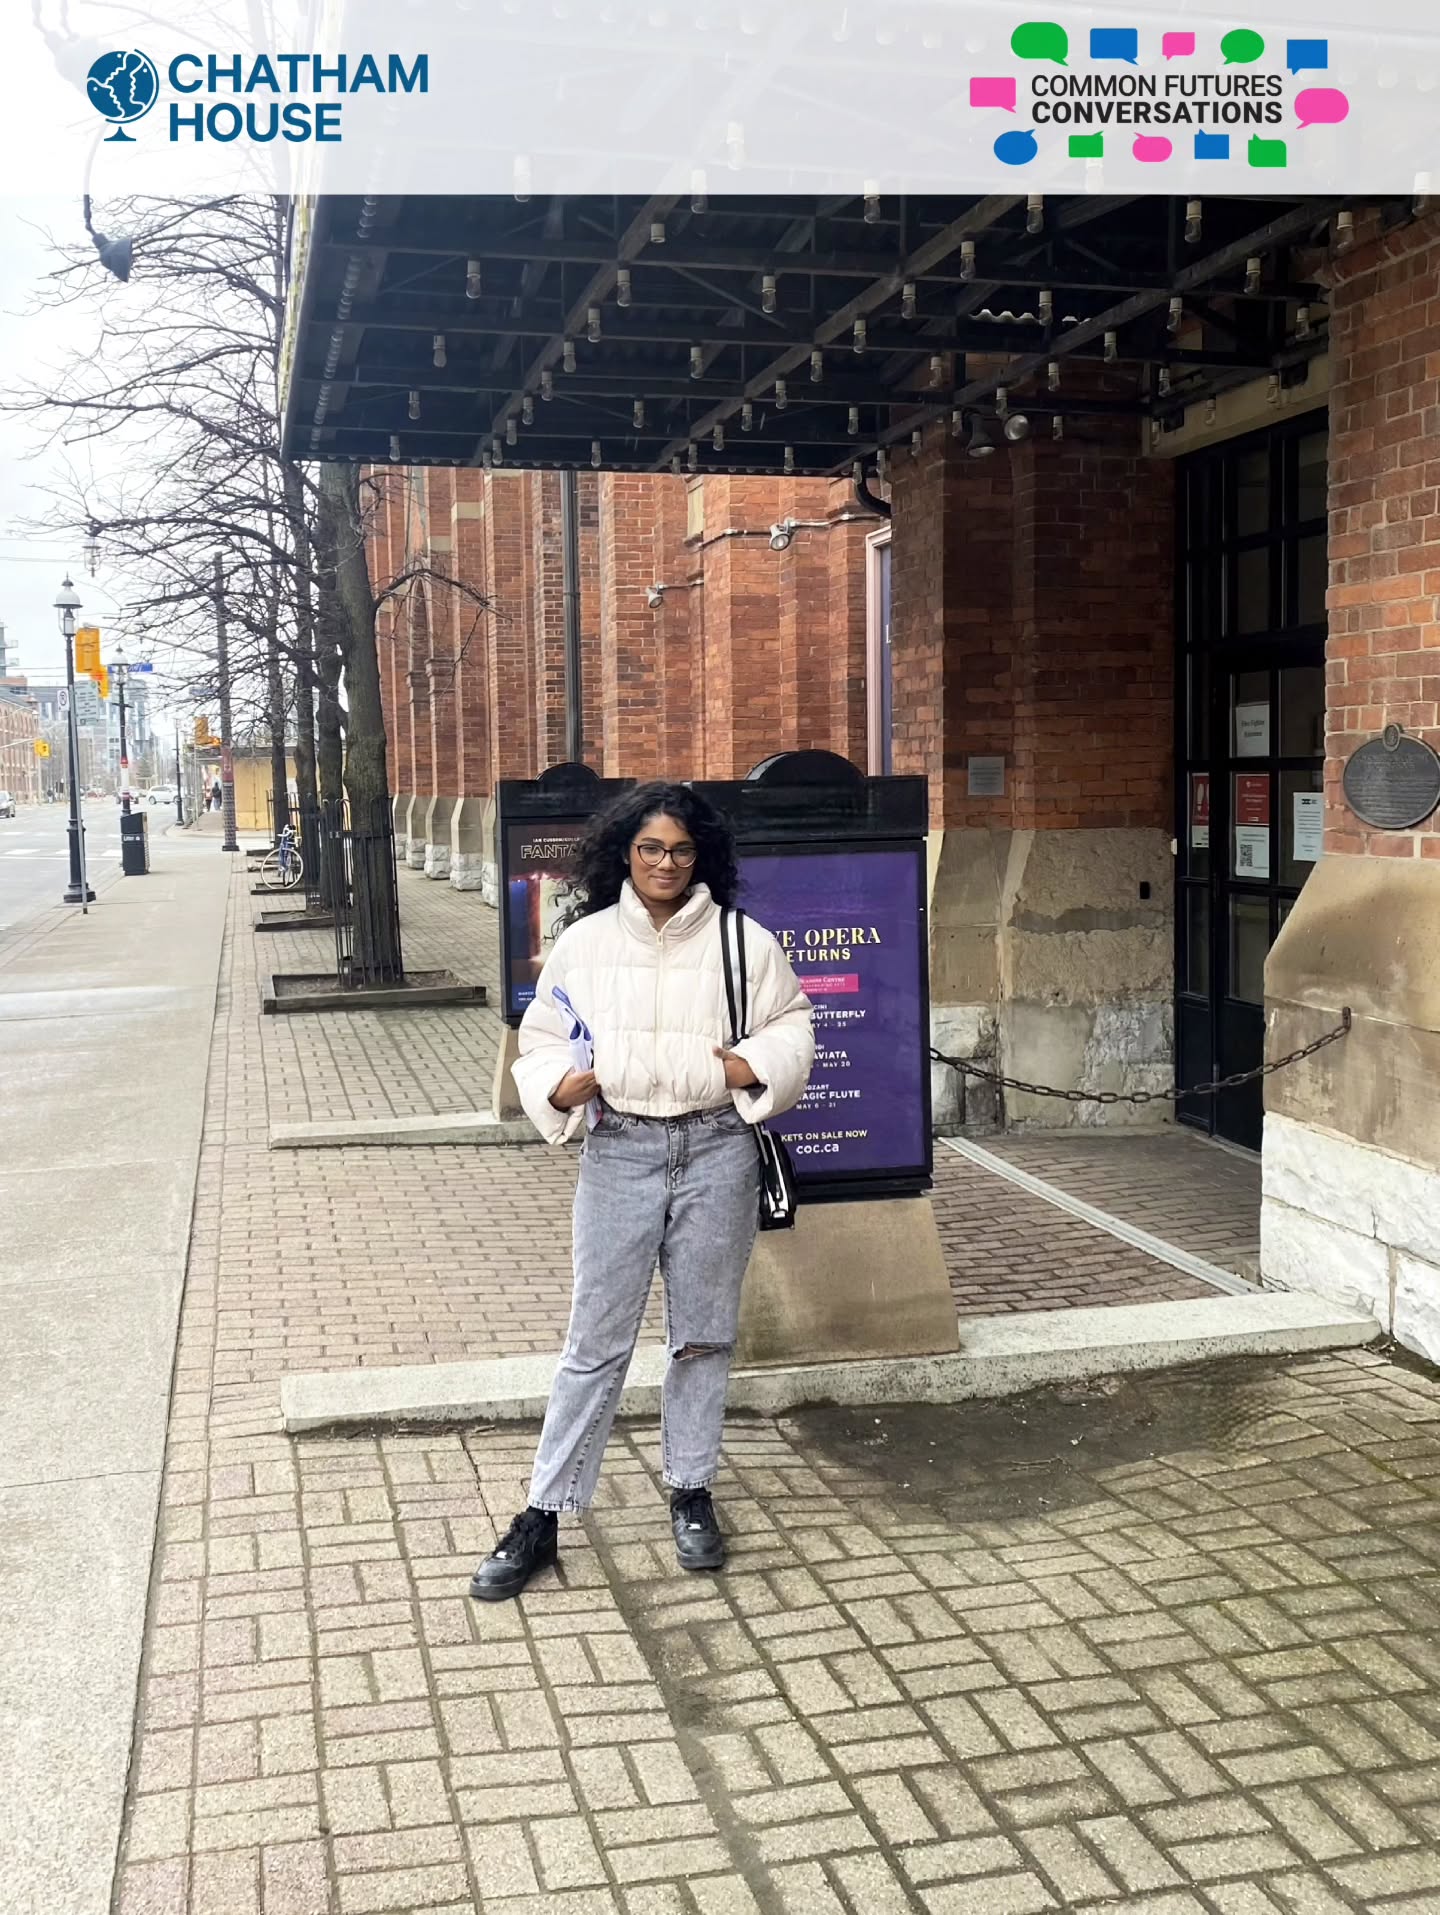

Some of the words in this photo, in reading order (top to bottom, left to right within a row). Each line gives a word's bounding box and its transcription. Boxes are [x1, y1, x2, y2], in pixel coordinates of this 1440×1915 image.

[804, 926, 882, 947] OPERA
[810, 1010, 866, 1020] BUTTERFLY
[799, 1092, 827, 1101] AGIC
[829, 1090, 861, 1099] FLUTE
[805, 1132, 819, 1140] ON
[821, 1131, 844, 1139] SALE
[845, 1129, 868, 1138] NOW
[796, 1143, 840, 1155] coc.ca
